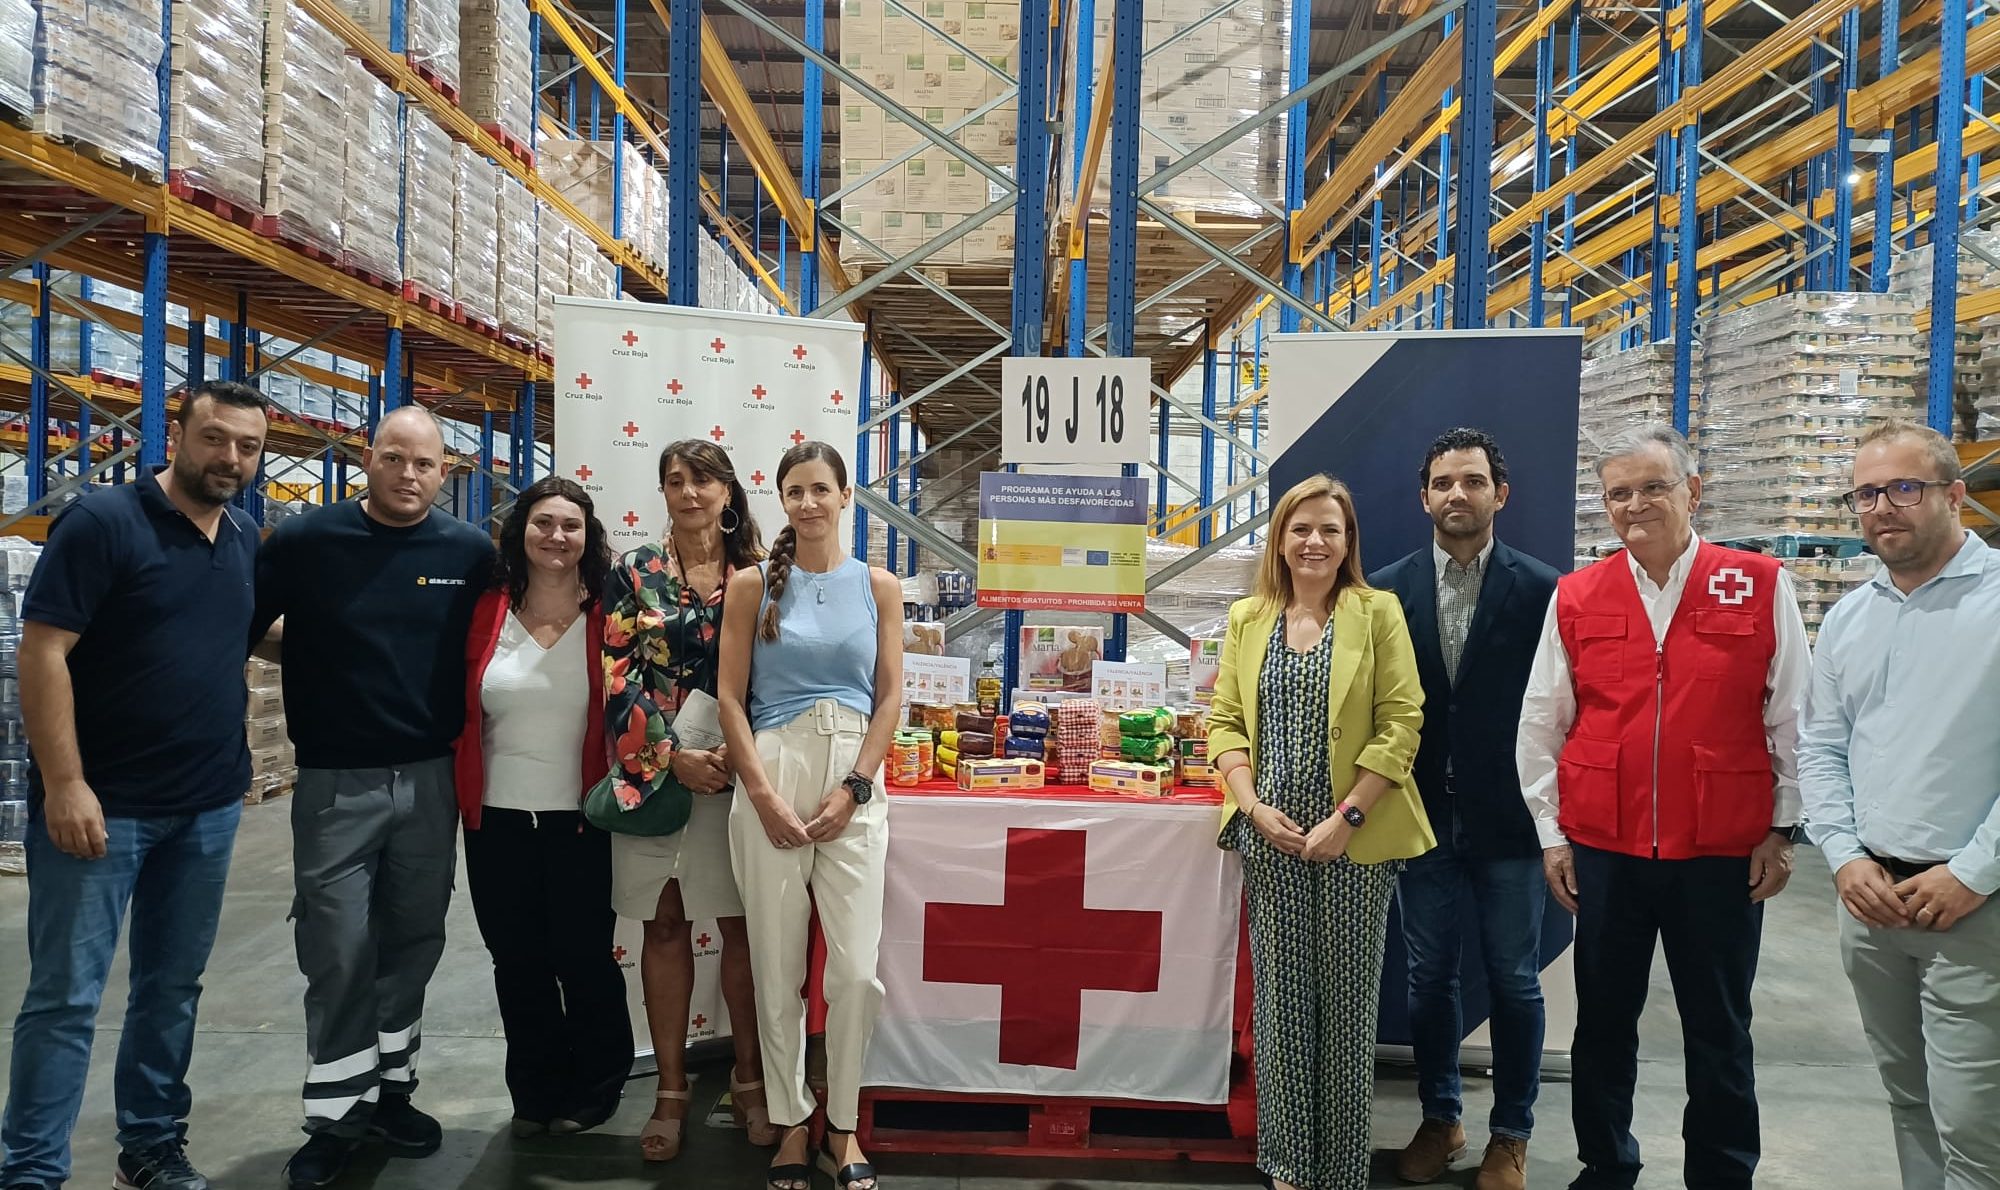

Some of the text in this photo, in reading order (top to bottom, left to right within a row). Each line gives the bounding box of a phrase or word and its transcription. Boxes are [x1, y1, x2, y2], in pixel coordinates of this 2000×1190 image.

[632, 350, 648, 358] Roja
[719, 357, 734, 365] Roja
[801, 363, 816, 371] Roja
[676, 398, 693, 406] Roja
[760, 403, 775, 411] Roja
[1022, 375, 1124, 444] 19 J 18
[586, 484, 603, 492] Roja
[1001, 485, 1050, 495] PROGRAMA
[1052, 487, 1063, 495] DE
[1065, 488, 1095, 496] AYUDA
[1104, 489, 1122, 497] LAS
[990, 495, 1135, 507] PERSONAS MÁS DESFAVORECIDAS
[632, 530, 648, 538] Roja
[981, 595, 1021, 604] ALIMENTOS
[1022, 597, 1063, 605] GRATUITOS
[1068, 598, 1106, 607] PROHIBIDA
[1118, 600, 1142, 608] VENTA
[704, 948, 720, 957] Roja
[700, 1029, 715, 1037] Roja
